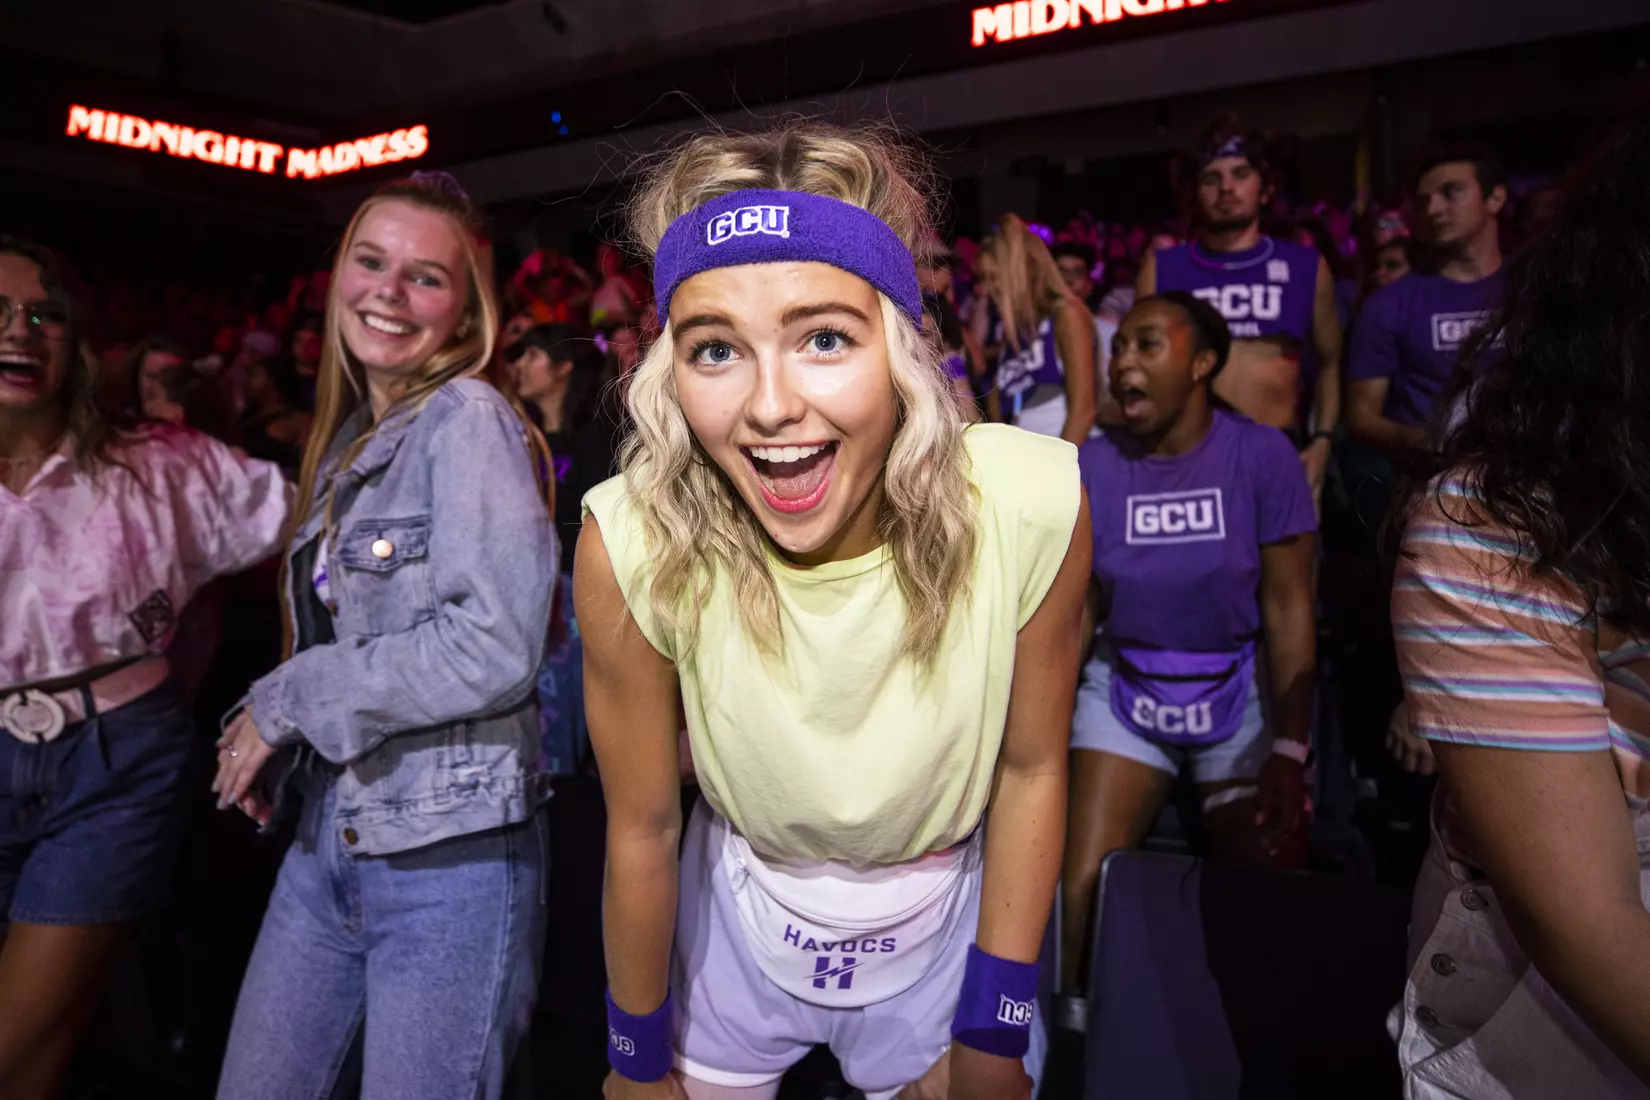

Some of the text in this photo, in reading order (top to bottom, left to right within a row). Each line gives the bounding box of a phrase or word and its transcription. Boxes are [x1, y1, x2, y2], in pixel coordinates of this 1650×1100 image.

[970, 0, 1236, 47] MIDNI
[66, 104, 429, 180] MIDNIGHT MADNESS
[707, 205, 790, 246] GCU
[1134, 499, 1214, 534] GCU
[1131, 695, 1213, 735] GCU
[783, 923, 897, 953] HAVOCS
[608, 1026, 635, 1056] GC
